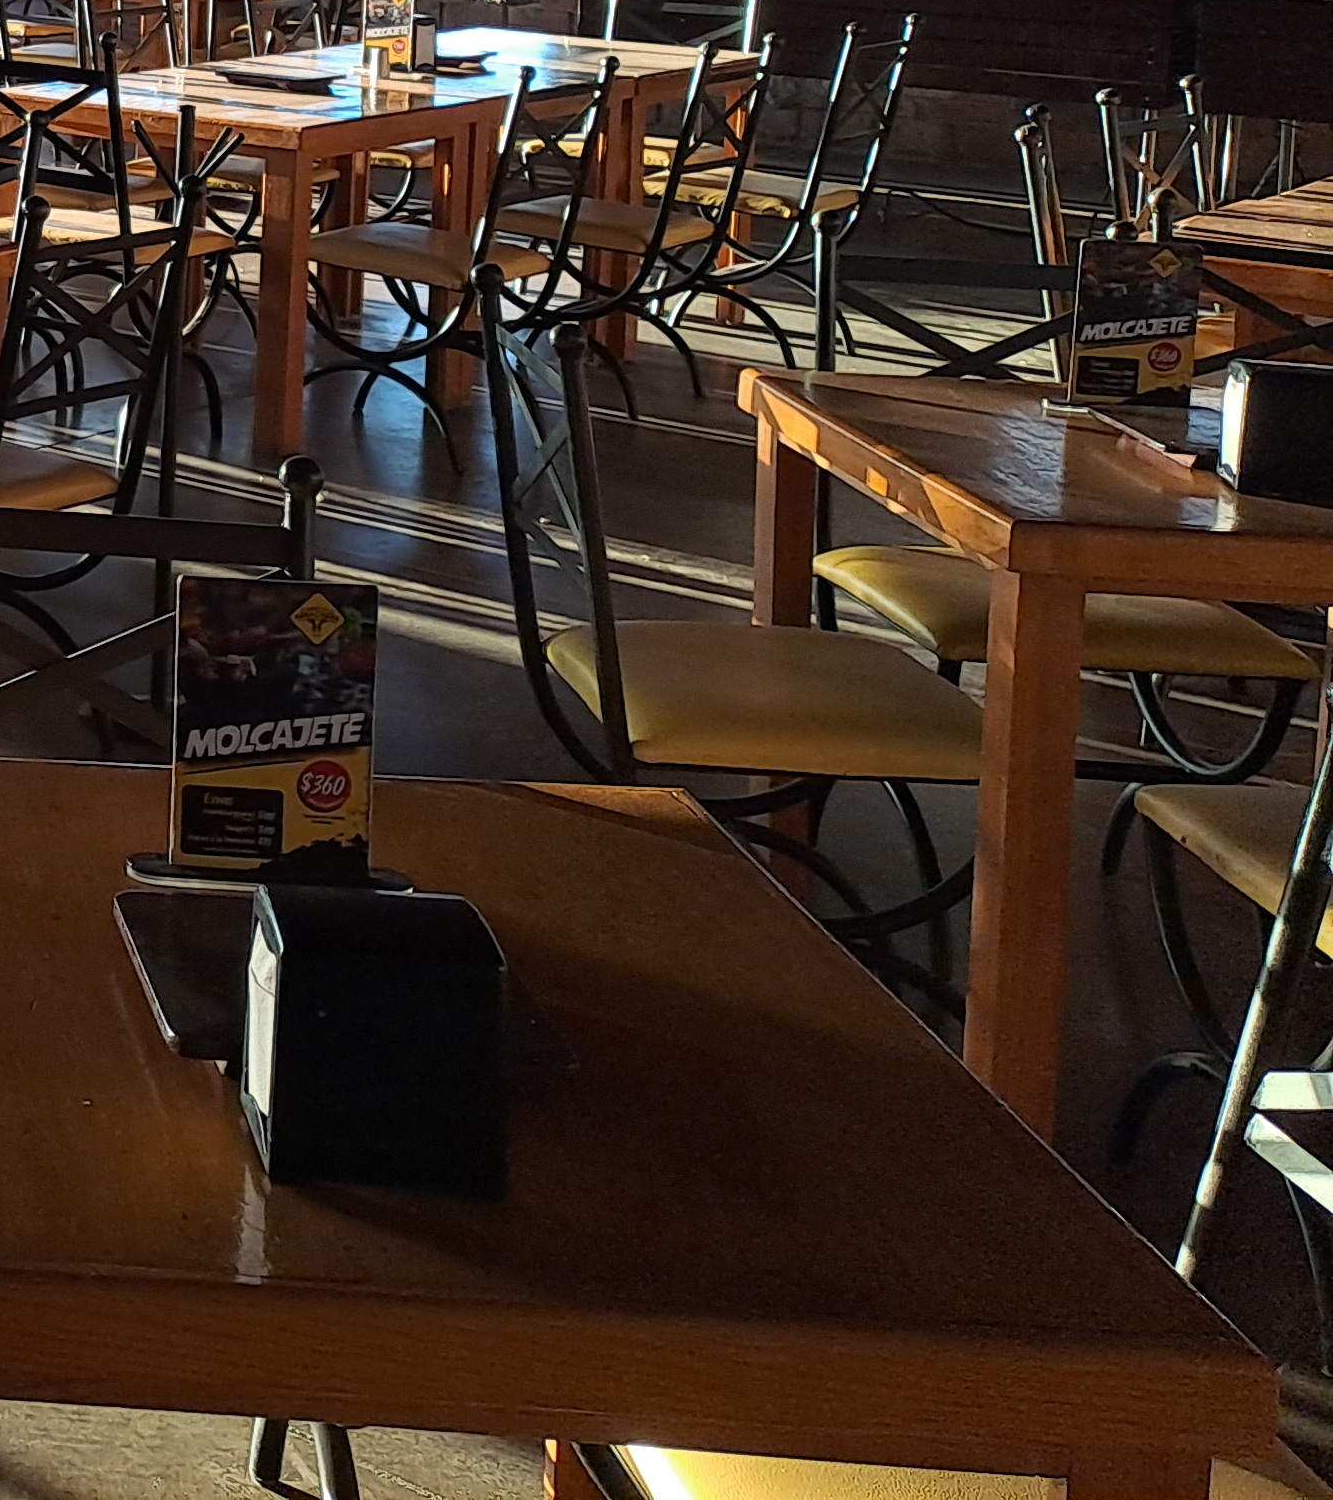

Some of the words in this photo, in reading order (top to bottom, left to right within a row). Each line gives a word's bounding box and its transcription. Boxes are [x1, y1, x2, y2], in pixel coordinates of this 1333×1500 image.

[1078, 315, 1193, 342] MOLCAJETE
[184, 712, 366, 759] MOLCAJETE
[300, 770, 346, 796] $360
